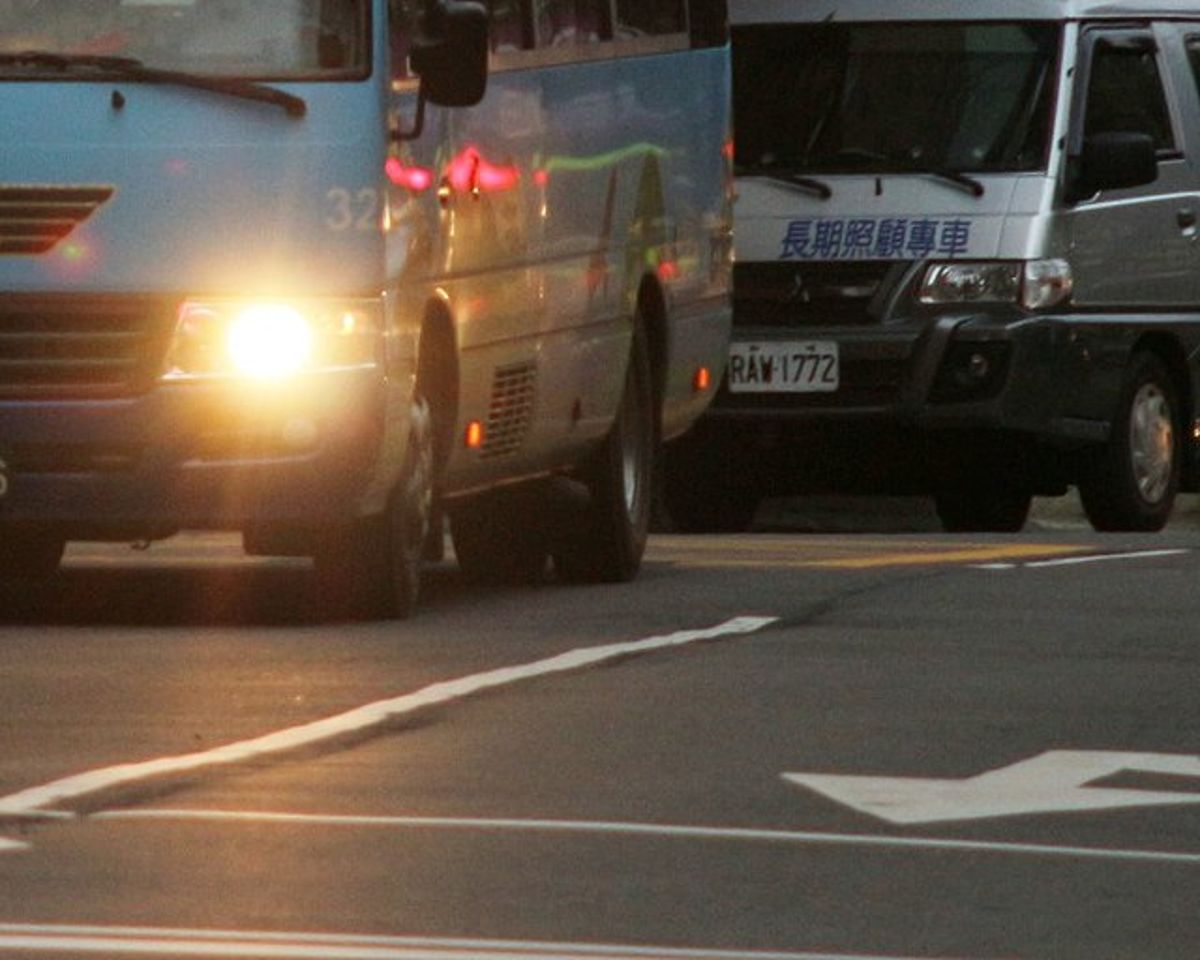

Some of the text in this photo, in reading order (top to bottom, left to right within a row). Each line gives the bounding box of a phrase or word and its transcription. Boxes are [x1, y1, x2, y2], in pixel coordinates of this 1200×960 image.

[780, 219, 972, 259] 長期照顧專車
[731, 353, 836, 384] RAW-1772
